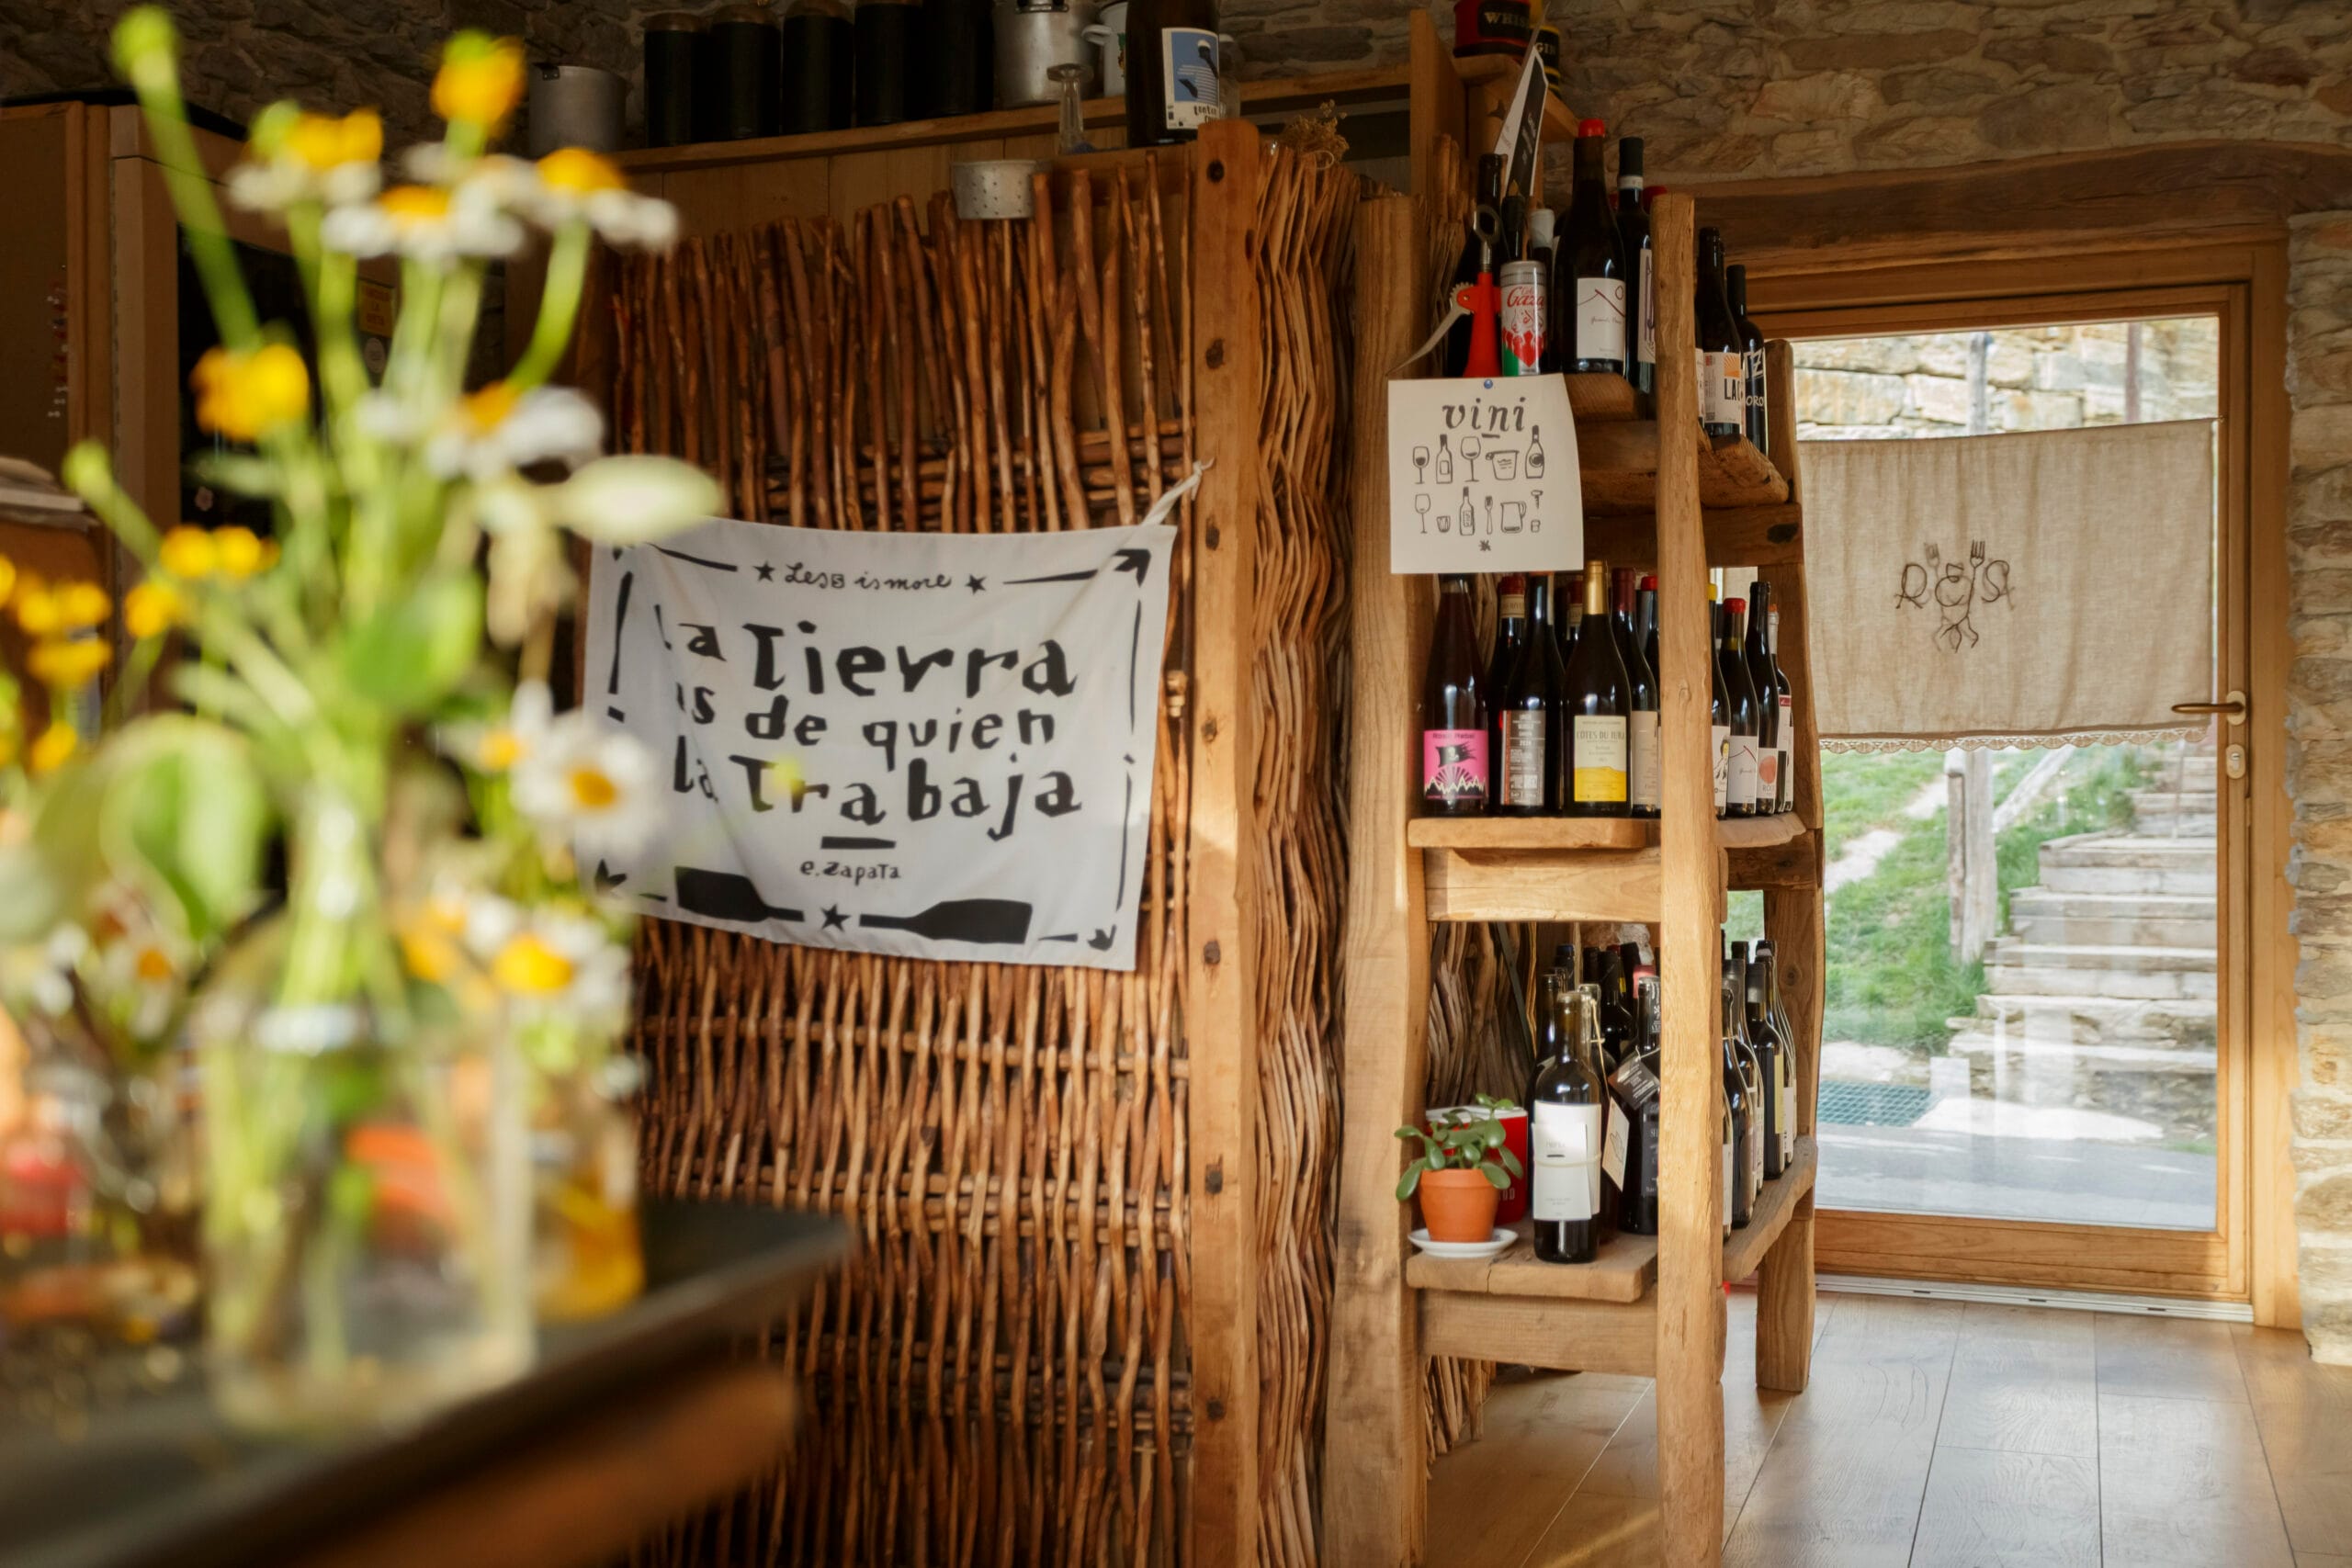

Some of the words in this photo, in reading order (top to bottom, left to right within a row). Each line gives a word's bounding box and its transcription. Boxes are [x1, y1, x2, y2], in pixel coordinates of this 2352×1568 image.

[1442, 397, 1526, 432] vini
[785, 562, 845, 590] Less
[742, 620, 1078, 699] Tierra
[745, 694, 828, 746] de
[863, 706, 1057, 772] quien
[729, 753, 1082, 841] Trabaja
